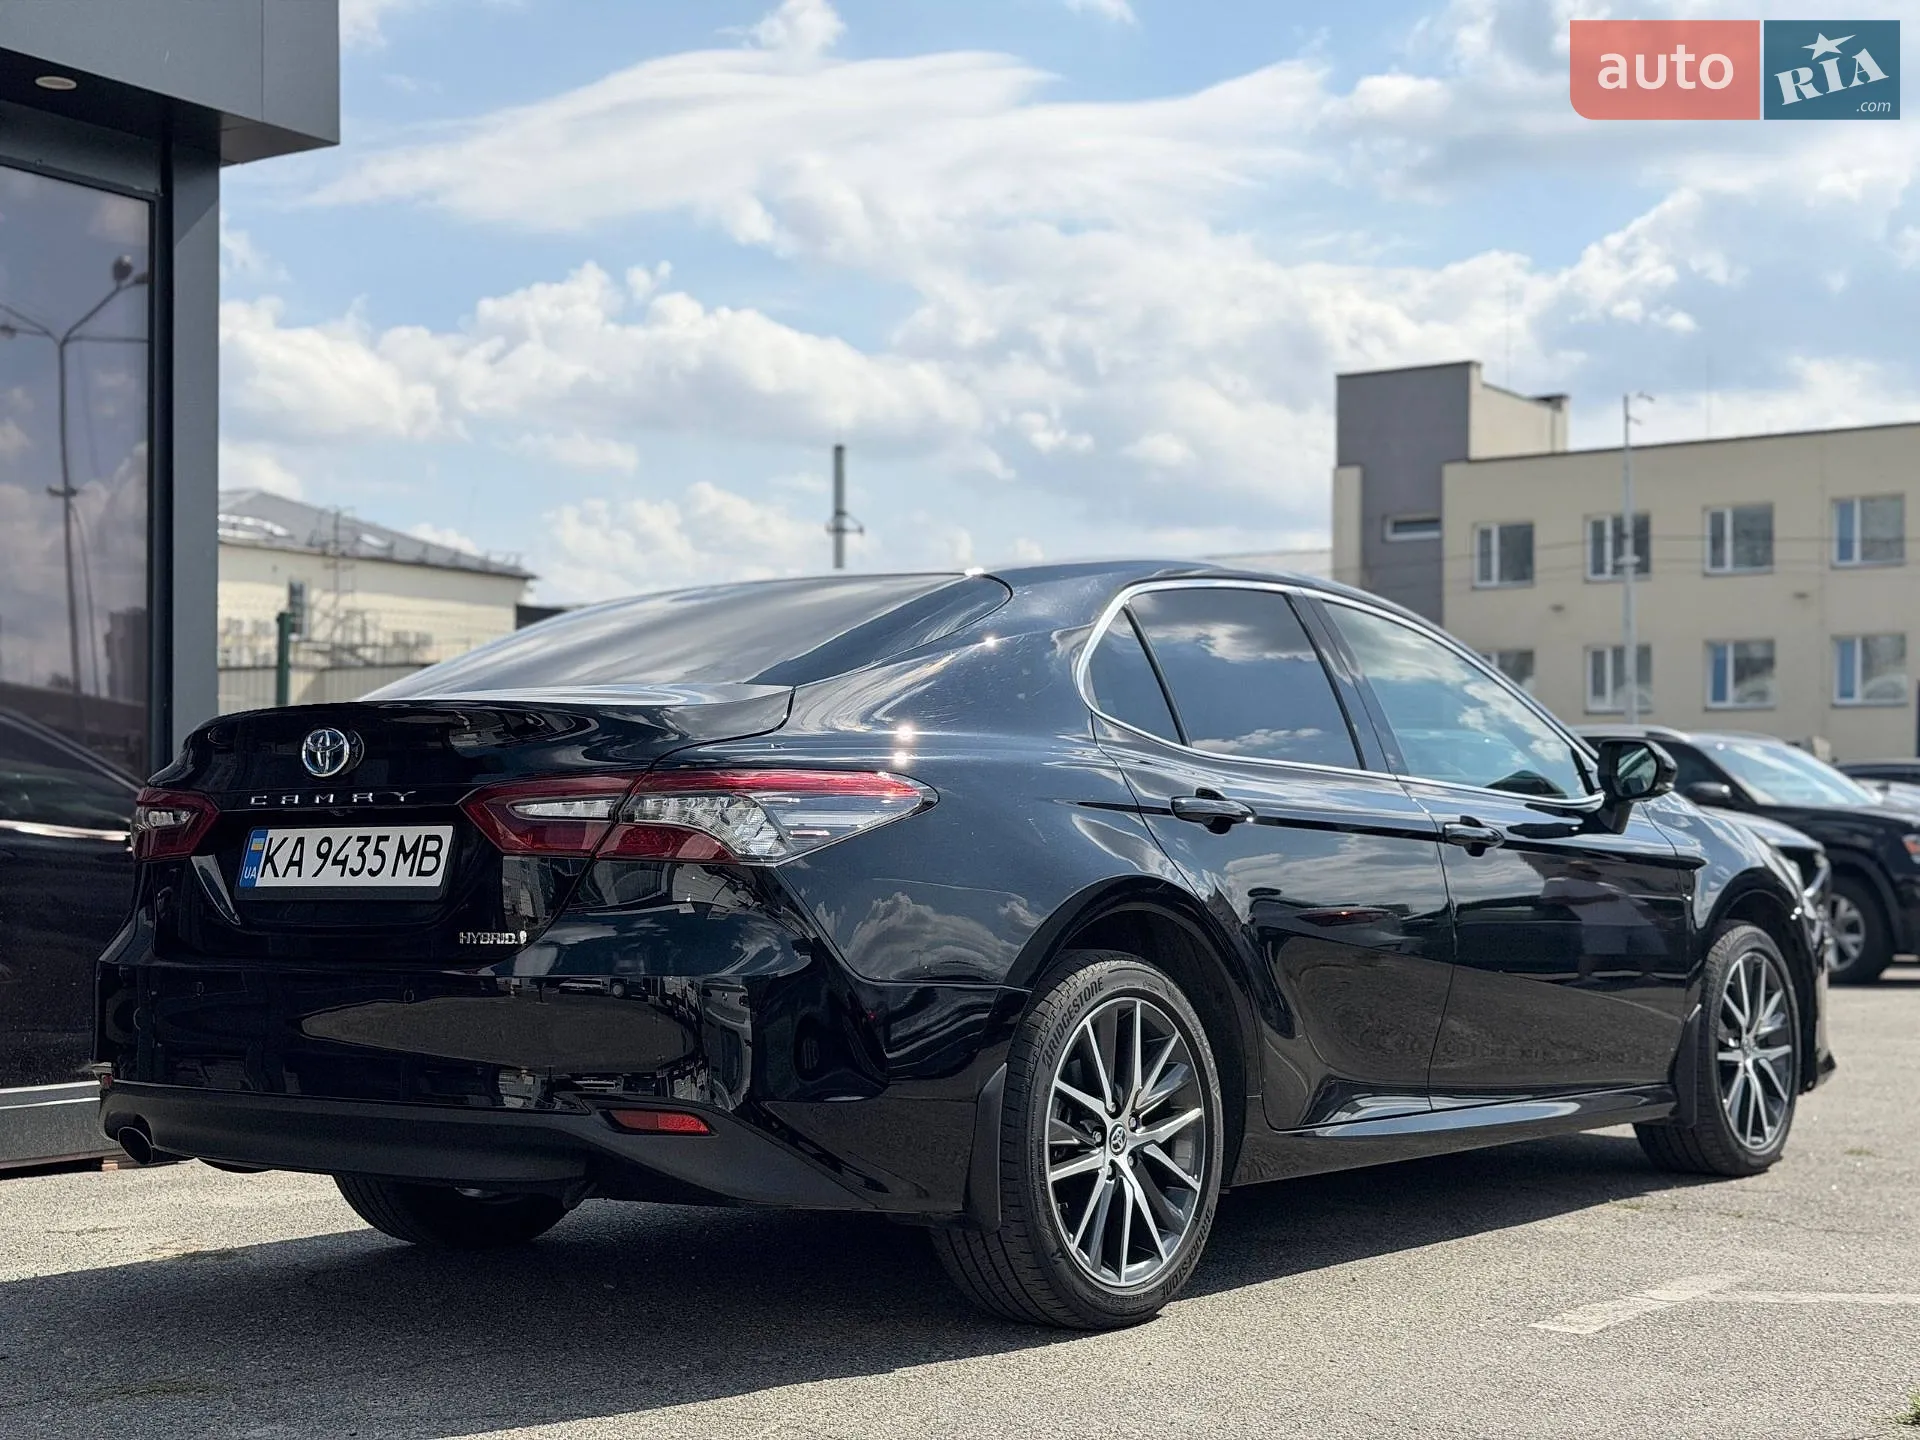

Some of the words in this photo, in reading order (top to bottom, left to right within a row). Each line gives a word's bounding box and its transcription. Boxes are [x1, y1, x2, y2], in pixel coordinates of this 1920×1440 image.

[249, 790, 417, 805] CAMRY
[244, 866, 258, 880] UA
[260, 836, 304, 878] KA
[312, 835, 391, 878] 9435
[392, 834, 444, 878] MB
[459, 931, 518, 945] HYBRID
[1041, 976, 1105, 1070] BRIDGESTONE
